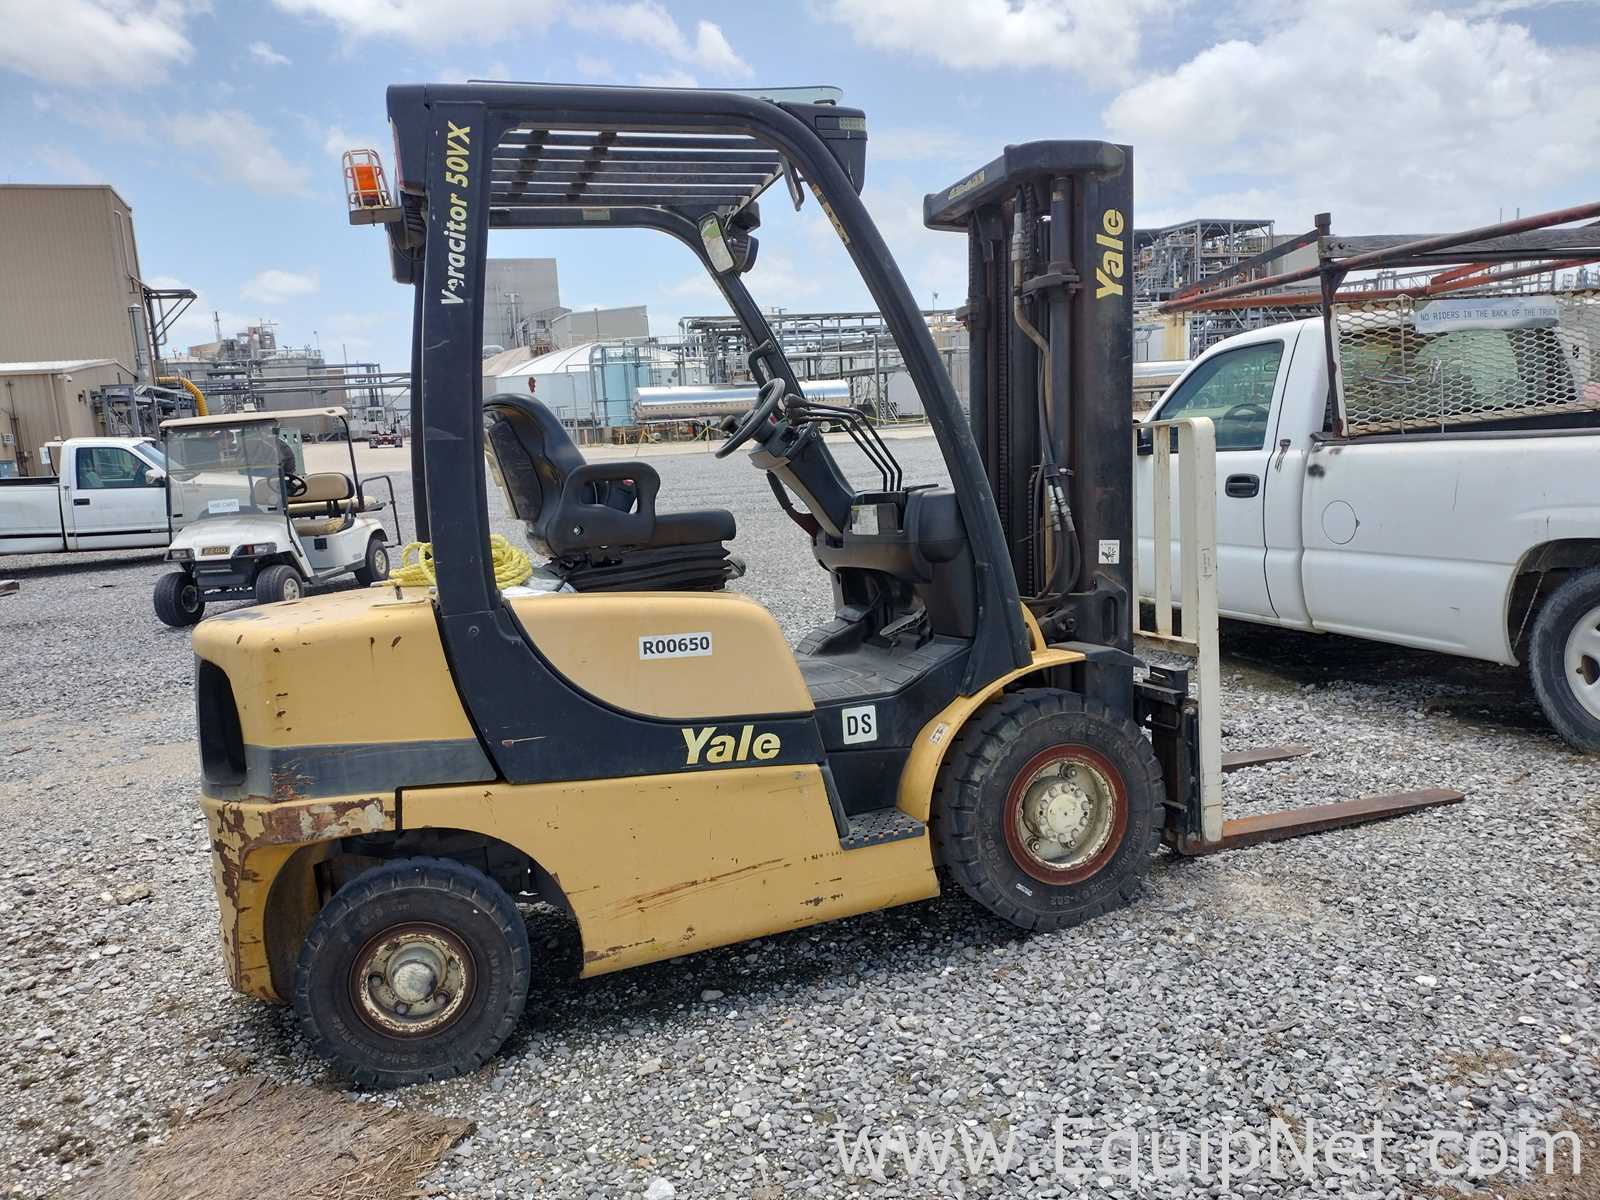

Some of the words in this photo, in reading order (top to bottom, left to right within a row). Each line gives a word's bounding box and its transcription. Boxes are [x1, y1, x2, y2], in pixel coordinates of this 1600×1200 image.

[446, 120, 471, 188] 50VX
[440, 192, 468, 304] Veracitor
[1095, 208, 1125, 299] Yale
[1420, 313, 1430, 321] NO
[1433, 310, 1459, 320] RIDERS
[1464, 310, 1472, 319] IN
[1476, 309, 1488, 319] THE
[1492, 308, 1508, 318] BACK
[1511, 308, 1520, 317] OF
[1524, 307, 1536, 316] THE
[642, 636, 710, 655] R00650
[847, 713, 872, 736] DS
[681, 725, 781, 765] Yale
